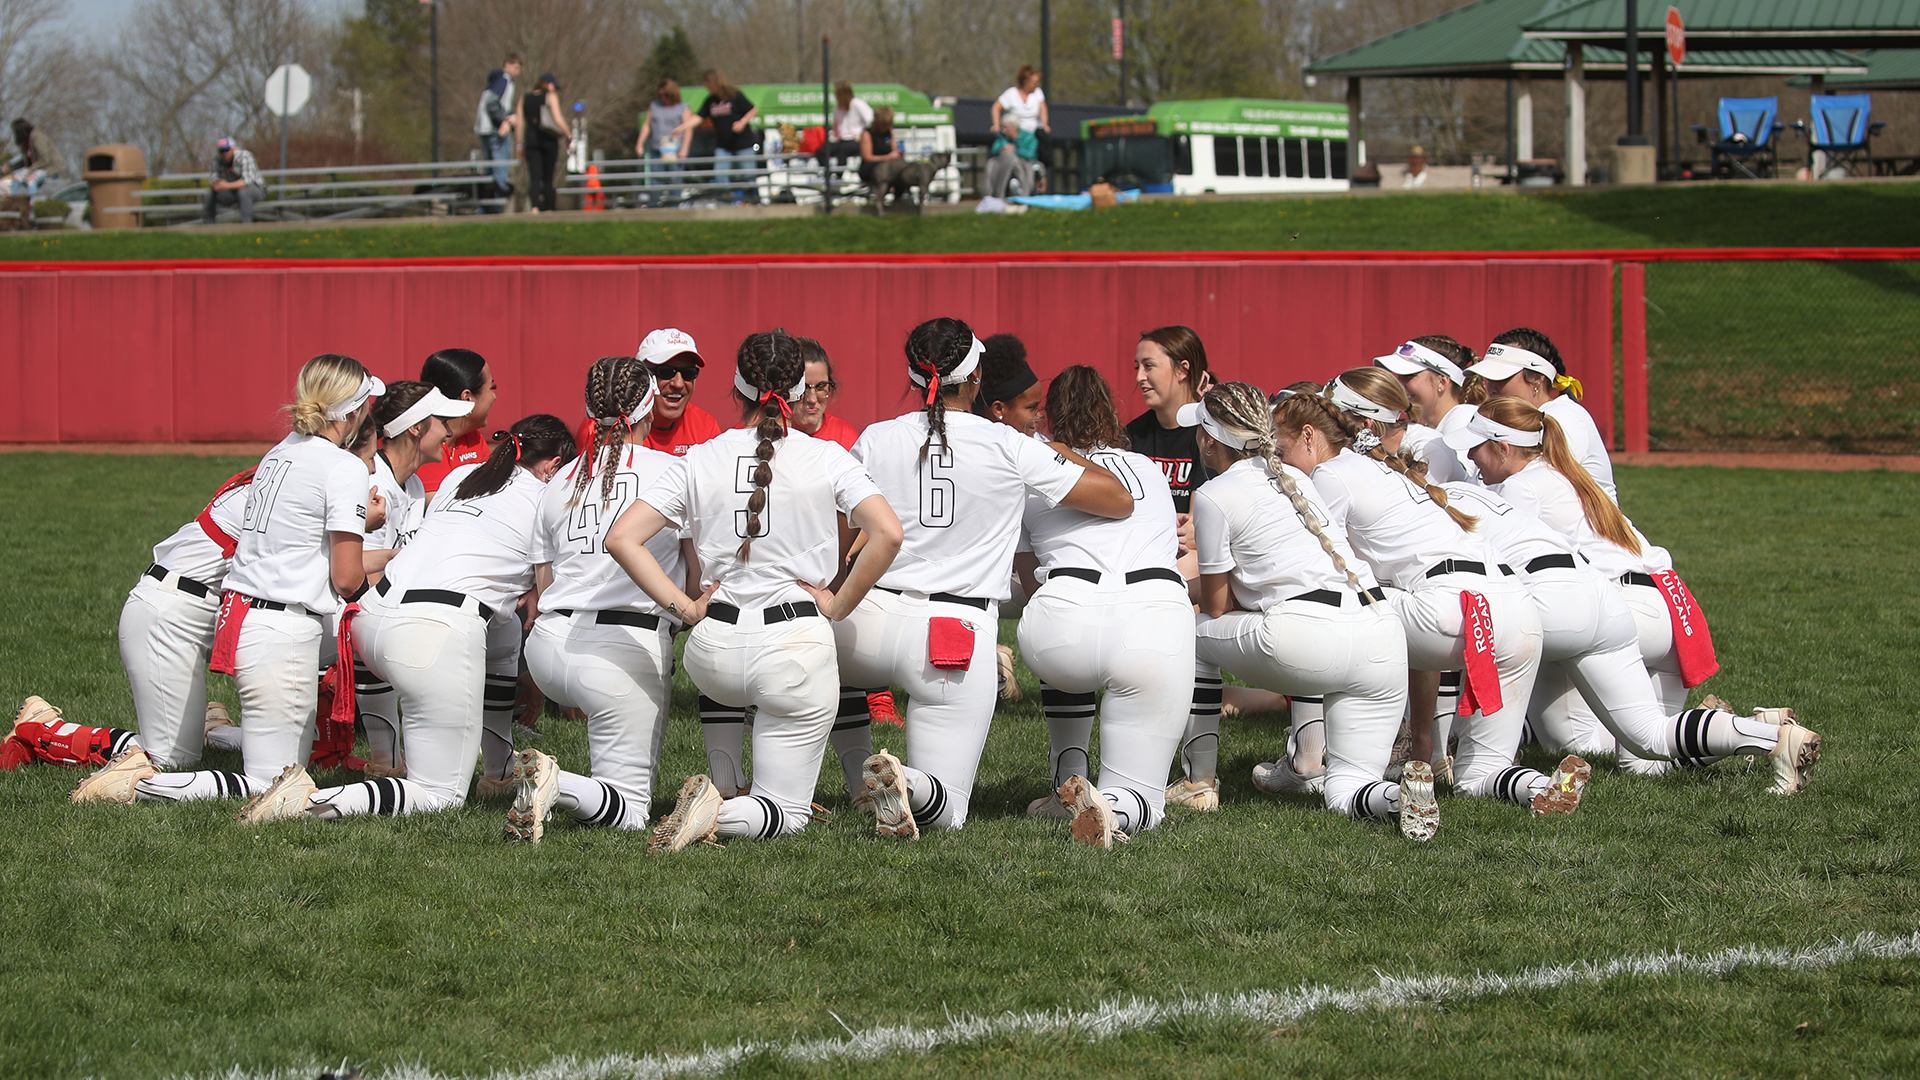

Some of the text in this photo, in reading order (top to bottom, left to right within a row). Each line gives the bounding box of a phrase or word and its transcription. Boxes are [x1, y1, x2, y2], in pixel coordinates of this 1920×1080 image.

[242, 458, 292, 534] 31
[567, 472, 639, 554] 42
[735, 455, 770, 538] 5
[919, 444, 955, 528] 6
[1470, 606, 1488, 654] ROLL
